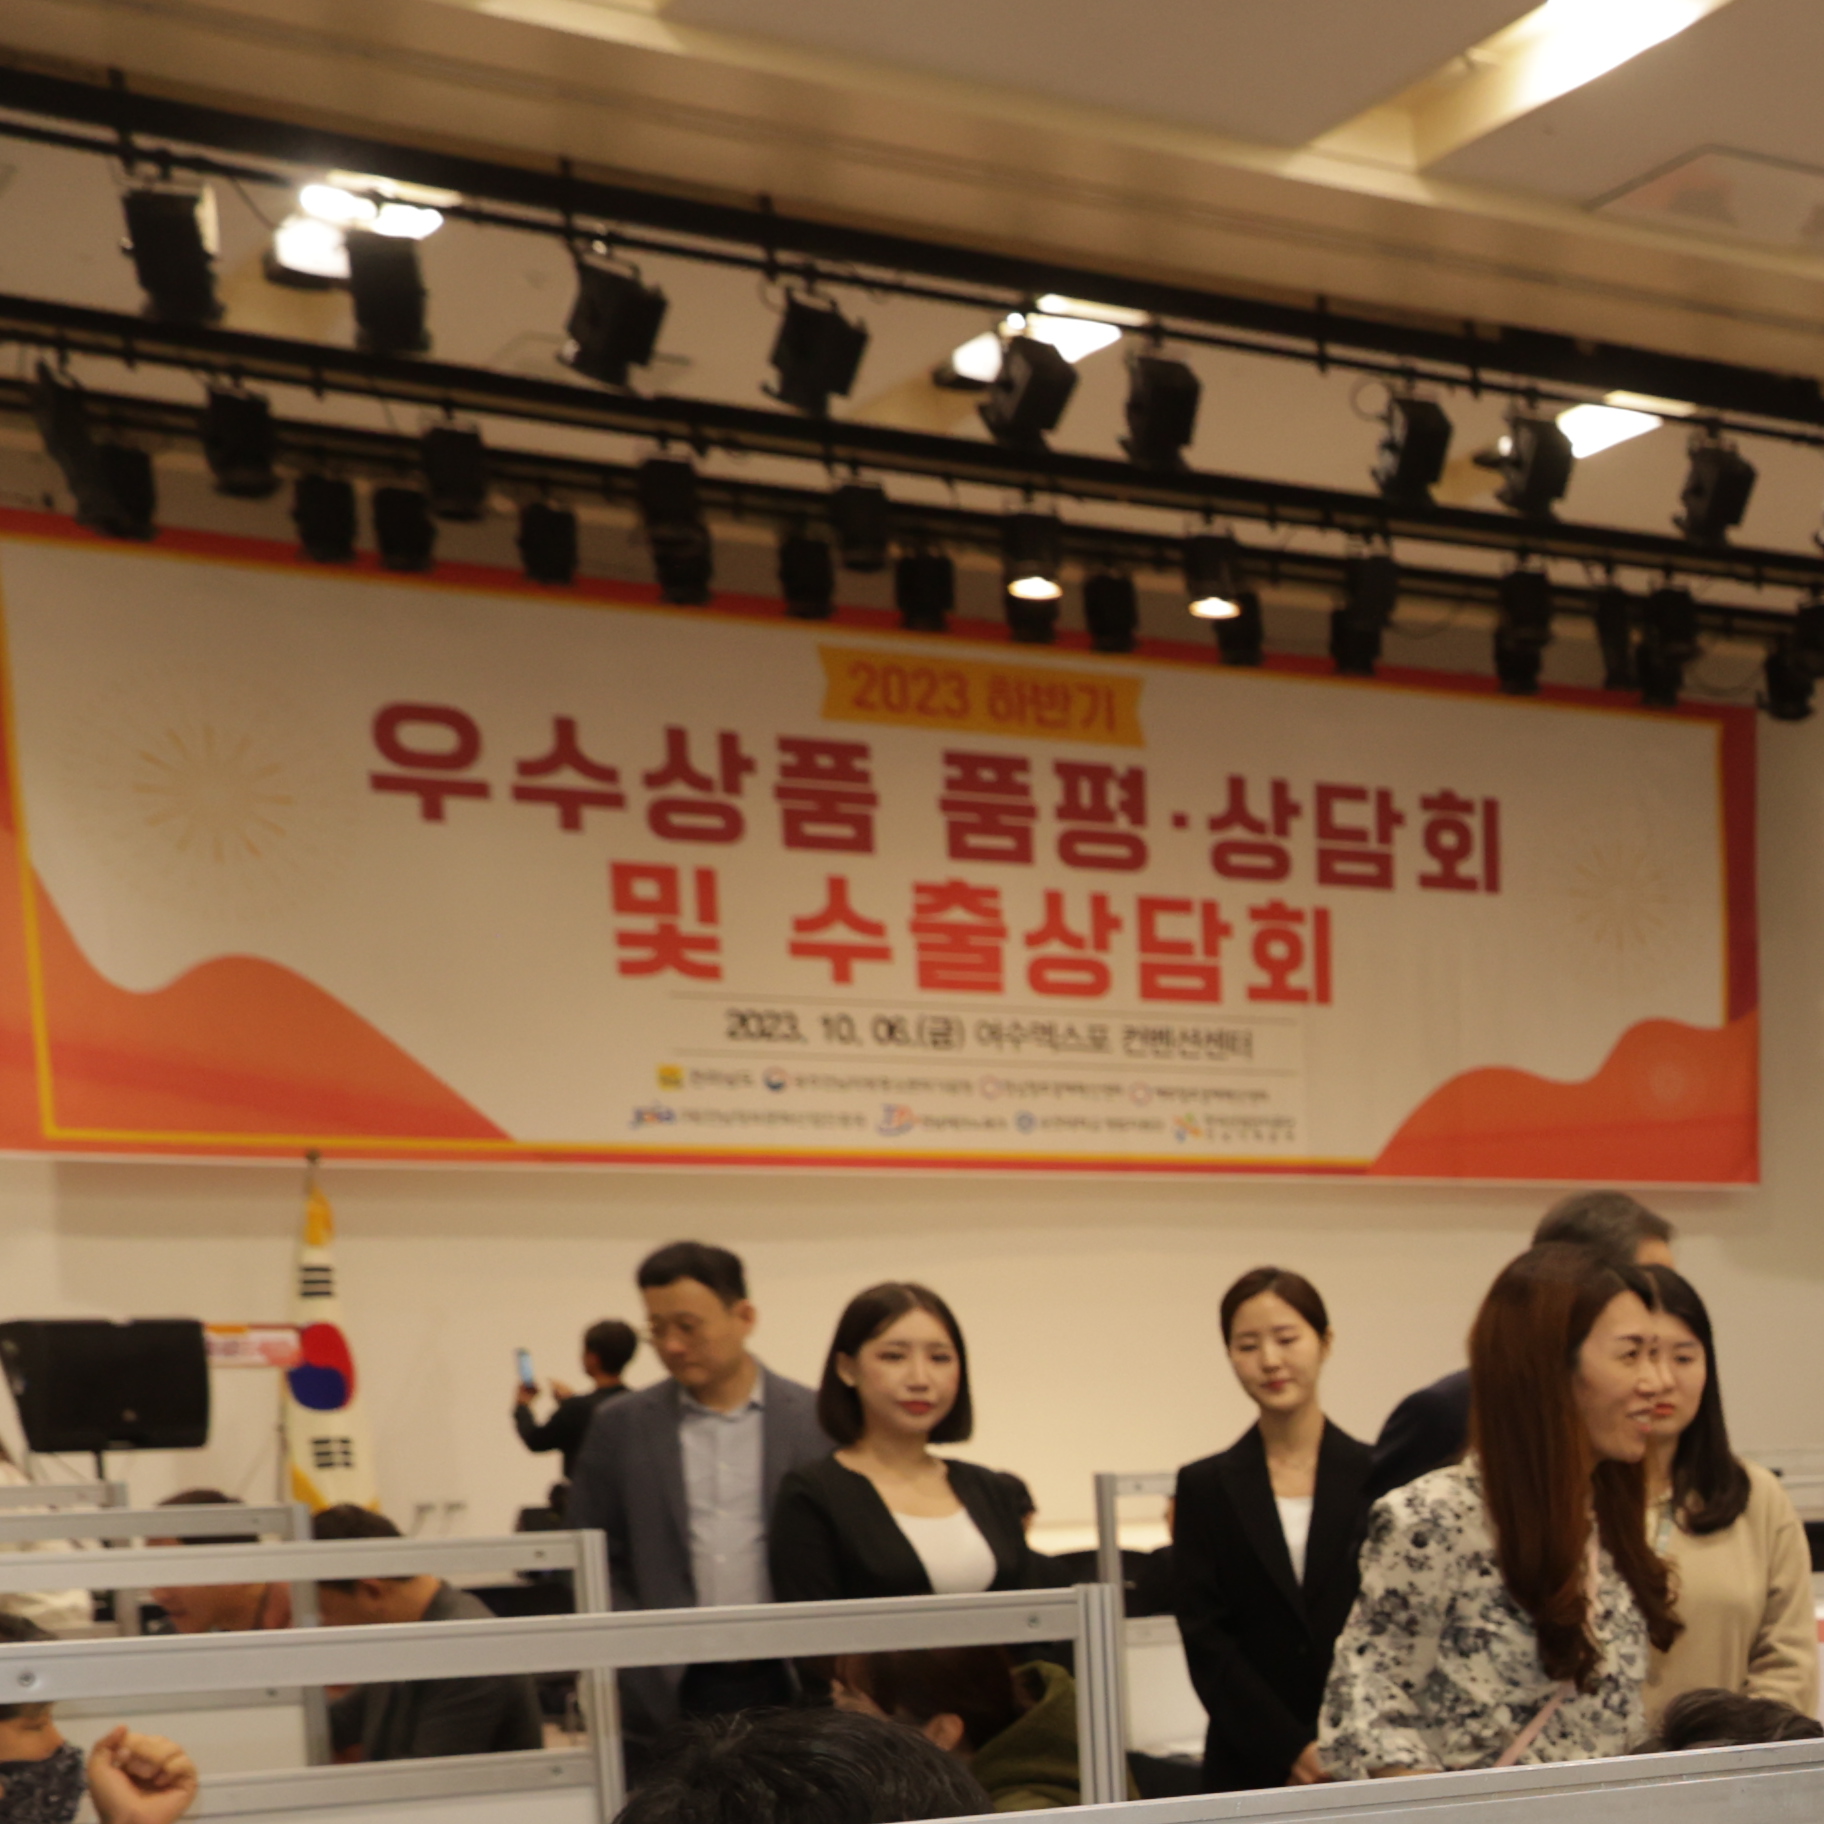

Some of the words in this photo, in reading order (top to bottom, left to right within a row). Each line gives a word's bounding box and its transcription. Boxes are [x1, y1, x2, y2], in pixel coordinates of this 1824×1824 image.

[848, 660, 970, 720] 2023
[984, 675, 1117, 733] 하반기
[368, 701, 880, 855] 우수상품
[938, 748, 1501, 895] 품평·상담회
[609, 859, 724, 982] 및
[787, 872, 1334, 1007] 수출상담회
